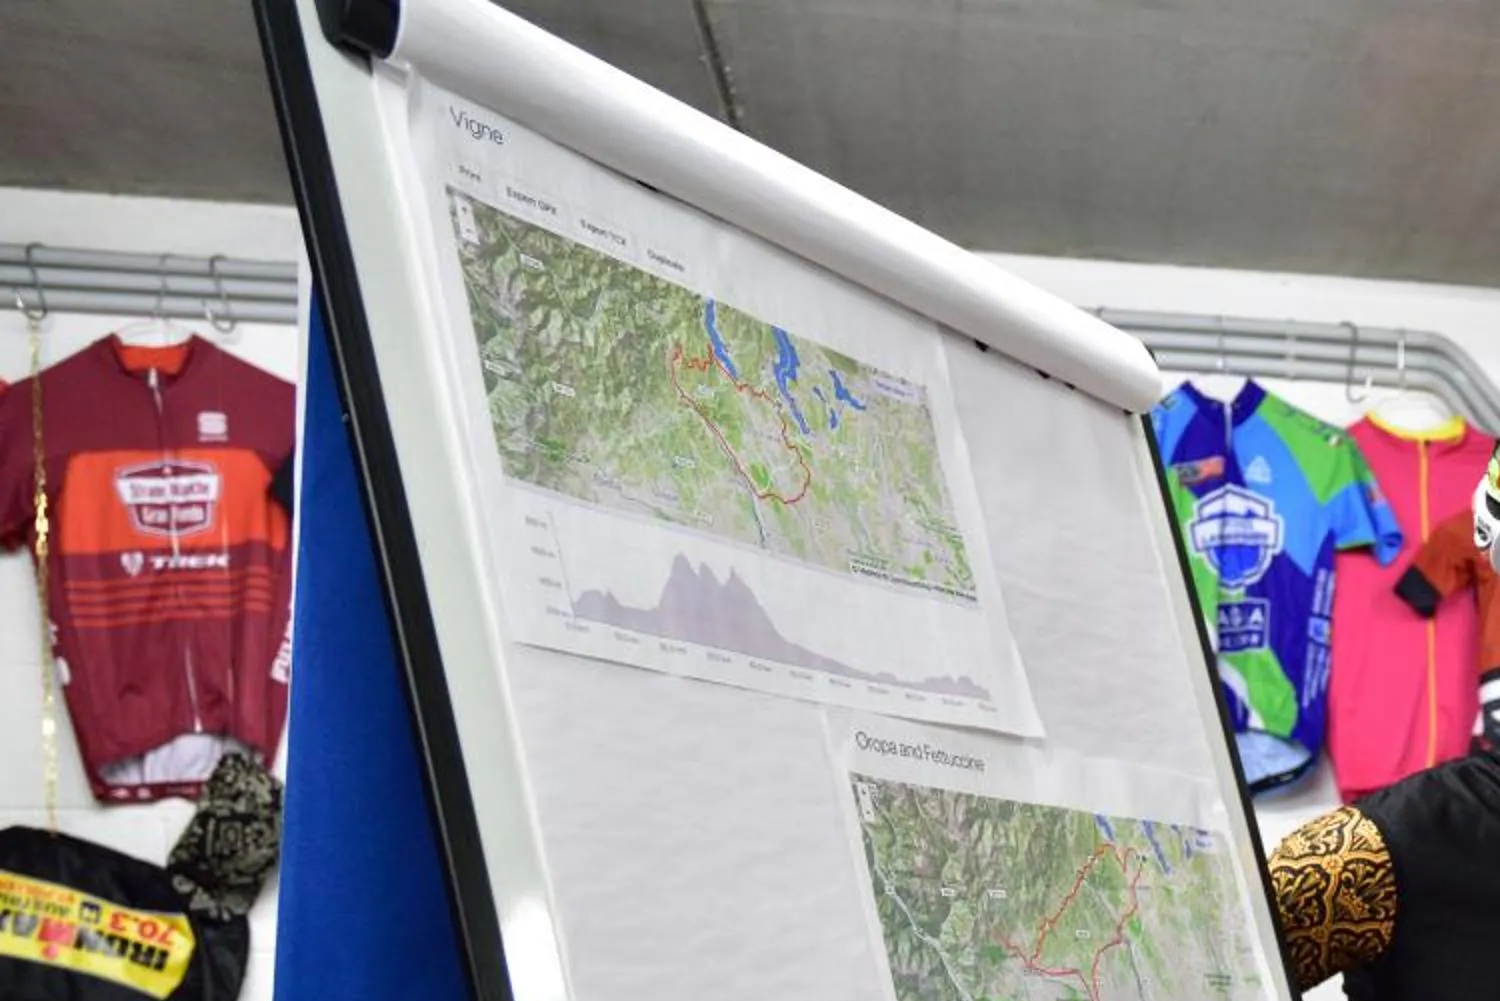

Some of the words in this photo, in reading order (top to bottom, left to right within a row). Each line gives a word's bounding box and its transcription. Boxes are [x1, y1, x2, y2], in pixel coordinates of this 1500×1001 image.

[449, 105, 505, 145] Vigne
[855, 730, 897, 757] Oropa
[899, 742, 923, 761] and
